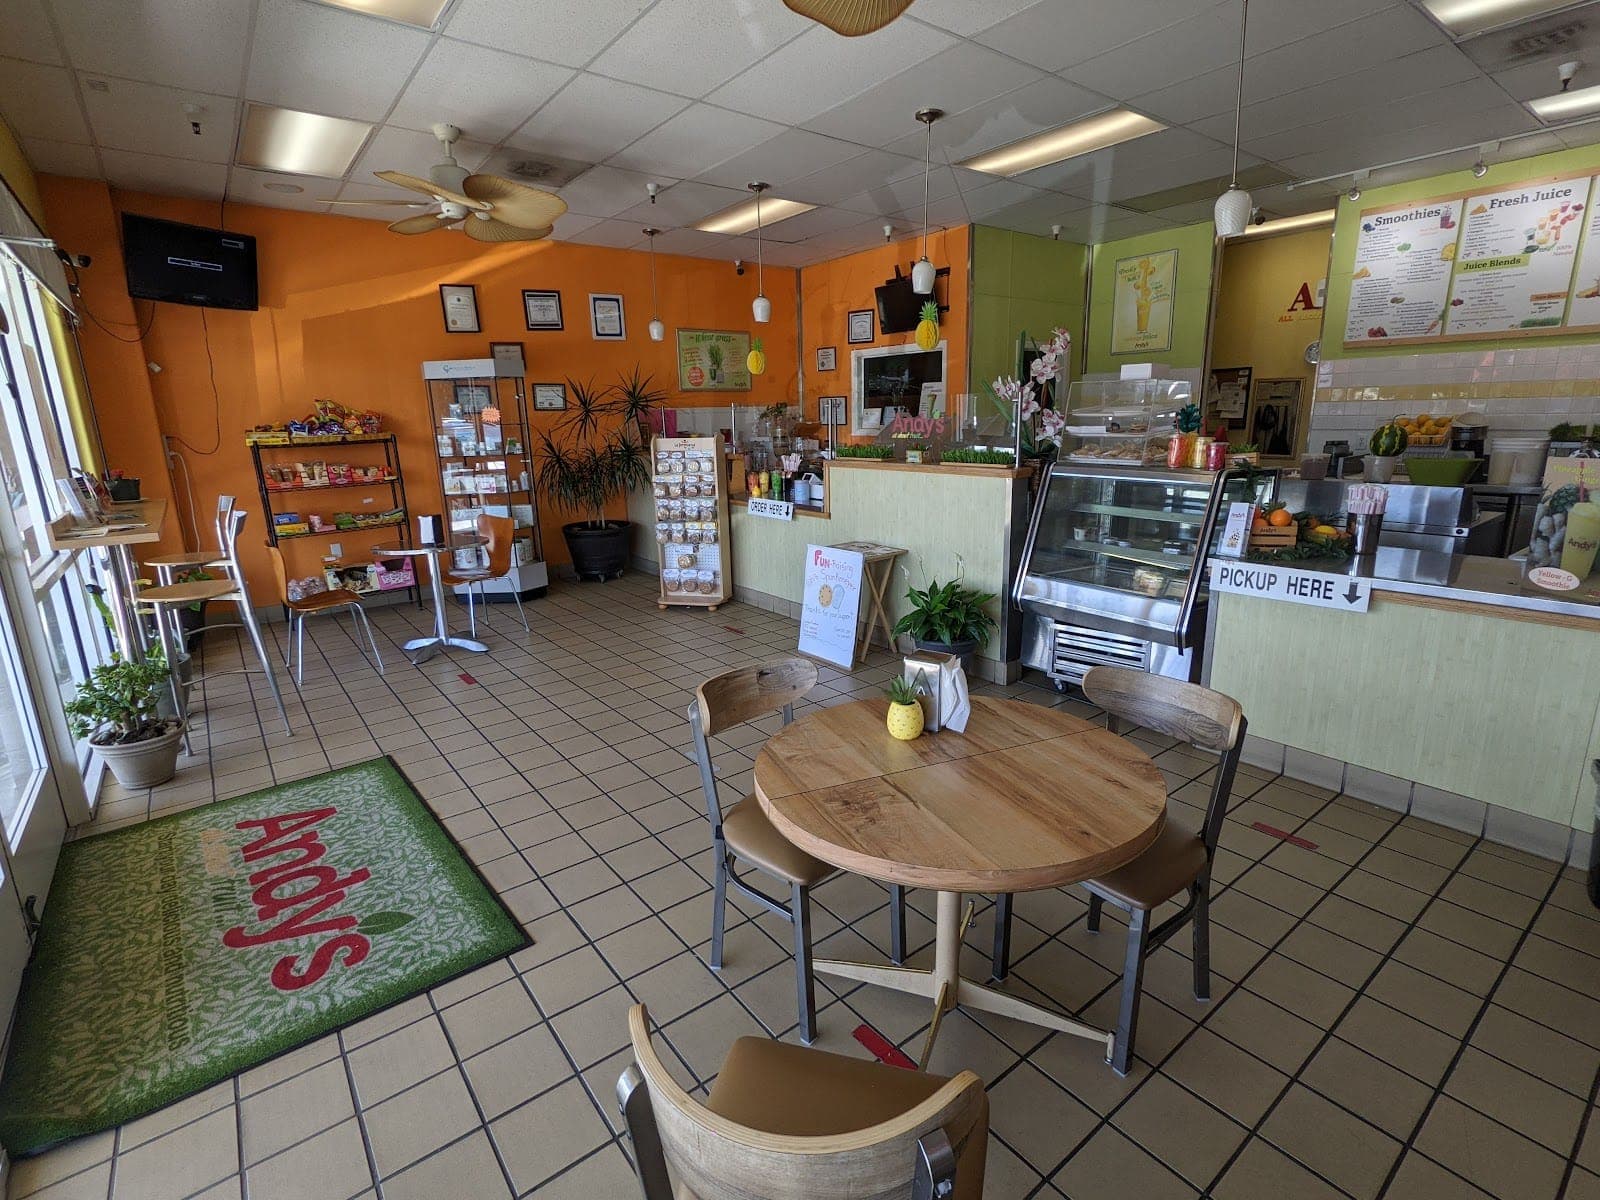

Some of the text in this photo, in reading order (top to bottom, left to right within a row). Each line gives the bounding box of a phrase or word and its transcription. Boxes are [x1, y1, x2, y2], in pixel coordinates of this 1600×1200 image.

[1489, 187, 1573, 210] Fresh Juice
[1374, 208, 1441, 227] Smoothies
[1463, 257, 1521, 271] Juice Blends
[750, 501, 784, 516] ORDER HERE
[1219, 567, 1335, 600] PICKUP HERE
[162, 895, 184, 946] delicious
[163, 947, 188, 974] and
[165, 974, 193, 1051] nutritious
